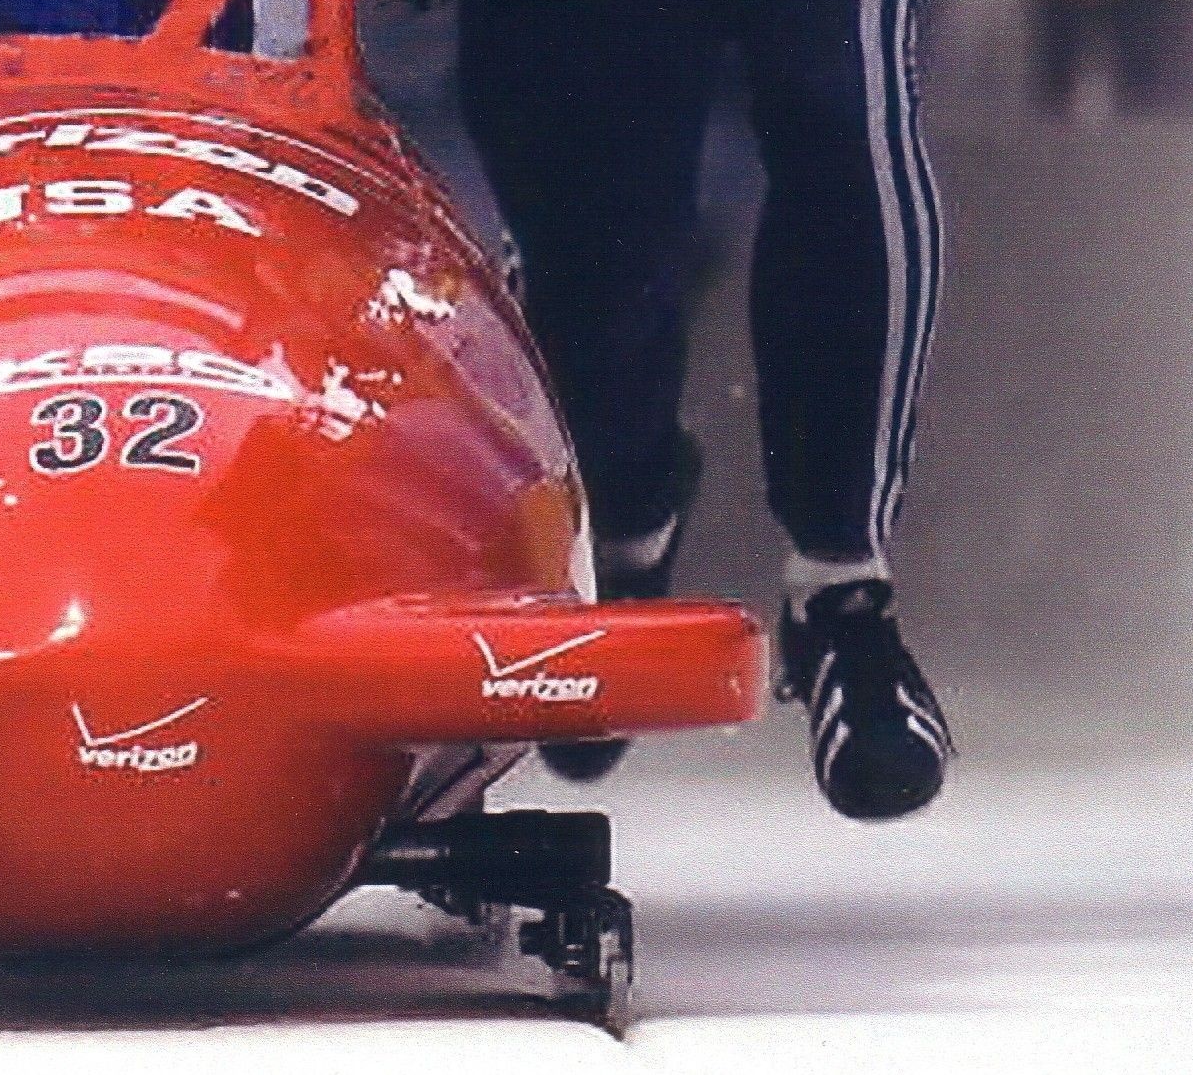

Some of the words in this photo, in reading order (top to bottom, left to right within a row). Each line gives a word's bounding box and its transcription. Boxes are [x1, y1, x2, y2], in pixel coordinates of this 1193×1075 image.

[30, 391, 203, 474] 32
[482, 672, 598, 702] verizon
[78, 741, 198, 771] verizon
